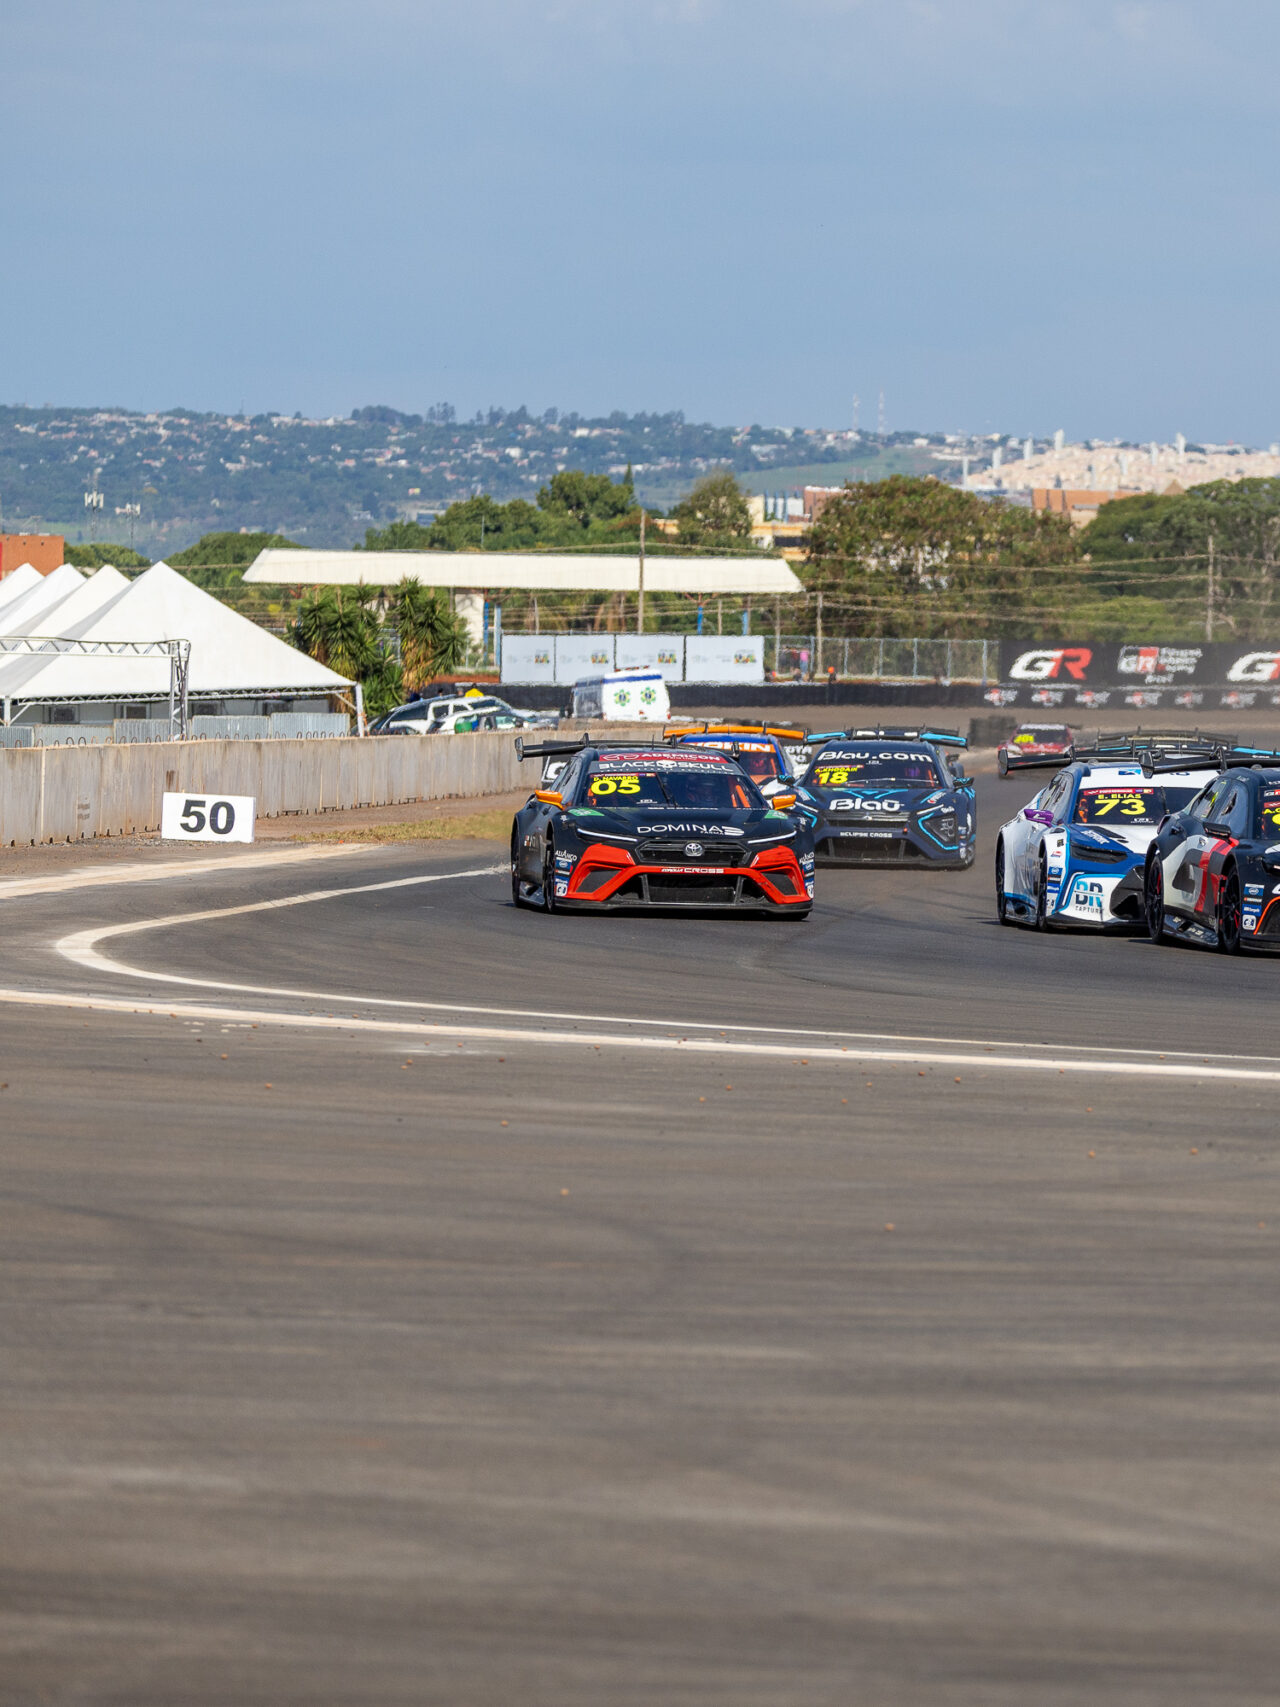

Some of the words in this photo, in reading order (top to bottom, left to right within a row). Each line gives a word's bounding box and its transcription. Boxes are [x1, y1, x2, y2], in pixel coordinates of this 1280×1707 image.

[1009, 648, 1093, 681] GR
[693, 741, 771, 752] OKIN
[818, 751, 932, 763] Blau.com
[599, 761, 655, 770] BLACK
[677, 762, 734, 772] SKULL
[818, 772, 848, 785] 18
[590, 780, 641, 795] 05
[1094, 798, 1147, 816] 73
[180, 799, 236, 835] 50
[637, 824, 724, 834] DOMINA
